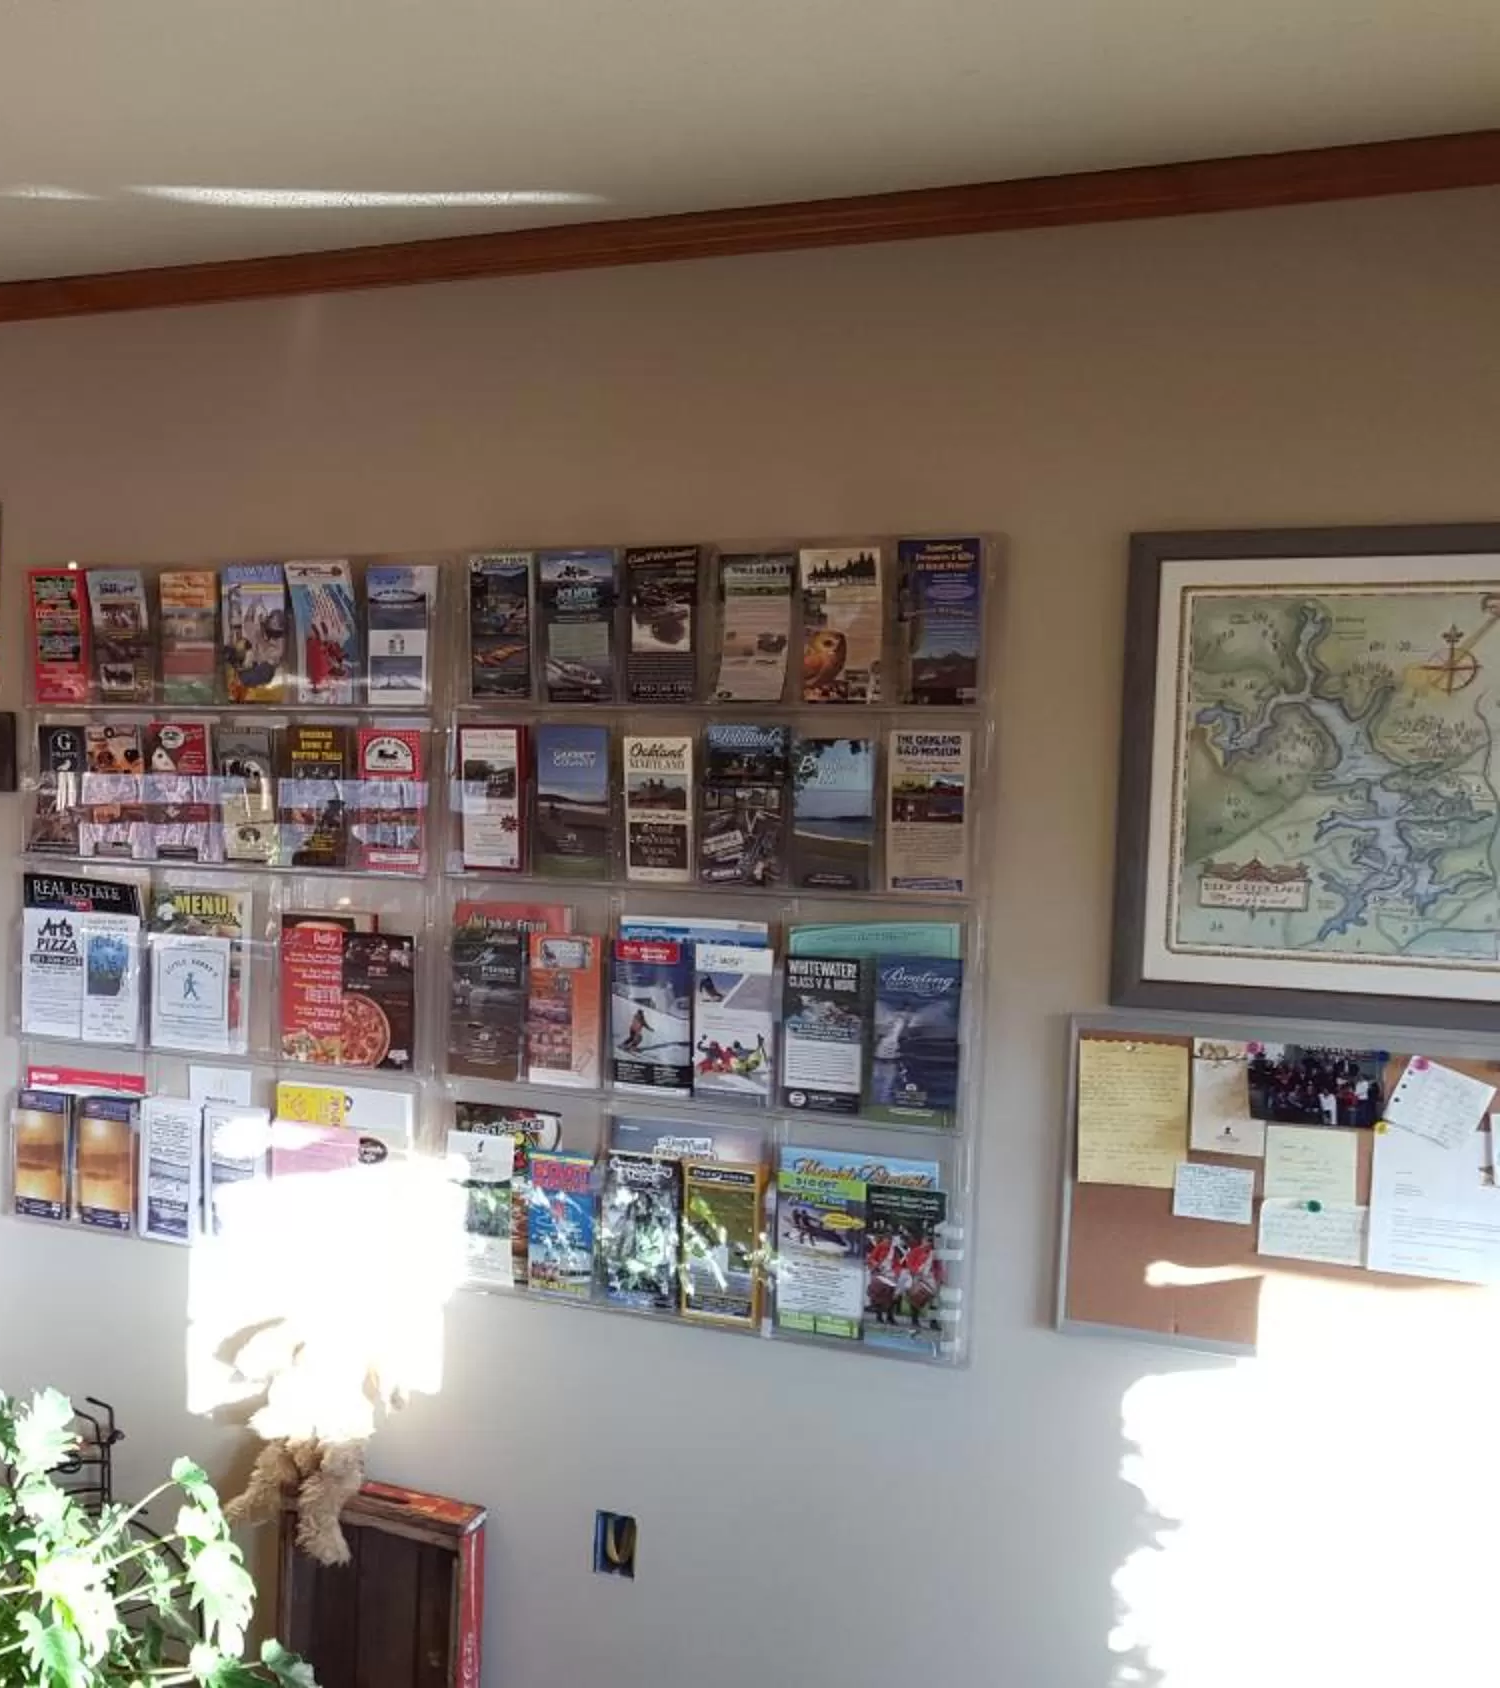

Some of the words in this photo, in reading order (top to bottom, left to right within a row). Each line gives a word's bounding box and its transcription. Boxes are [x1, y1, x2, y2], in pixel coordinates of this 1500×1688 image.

[896, 735, 913, 746] THE
[915, 735, 962, 747] OAKLAND
[630, 742, 687, 760] Oakland
[921, 746, 962, 757] MUSEUM
[33, 879, 69, 898] REAL
[71, 880, 122, 901] ESTATE
[174, 894, 229, 915] MENU
[37, 937, 78, 954] PIZZA
